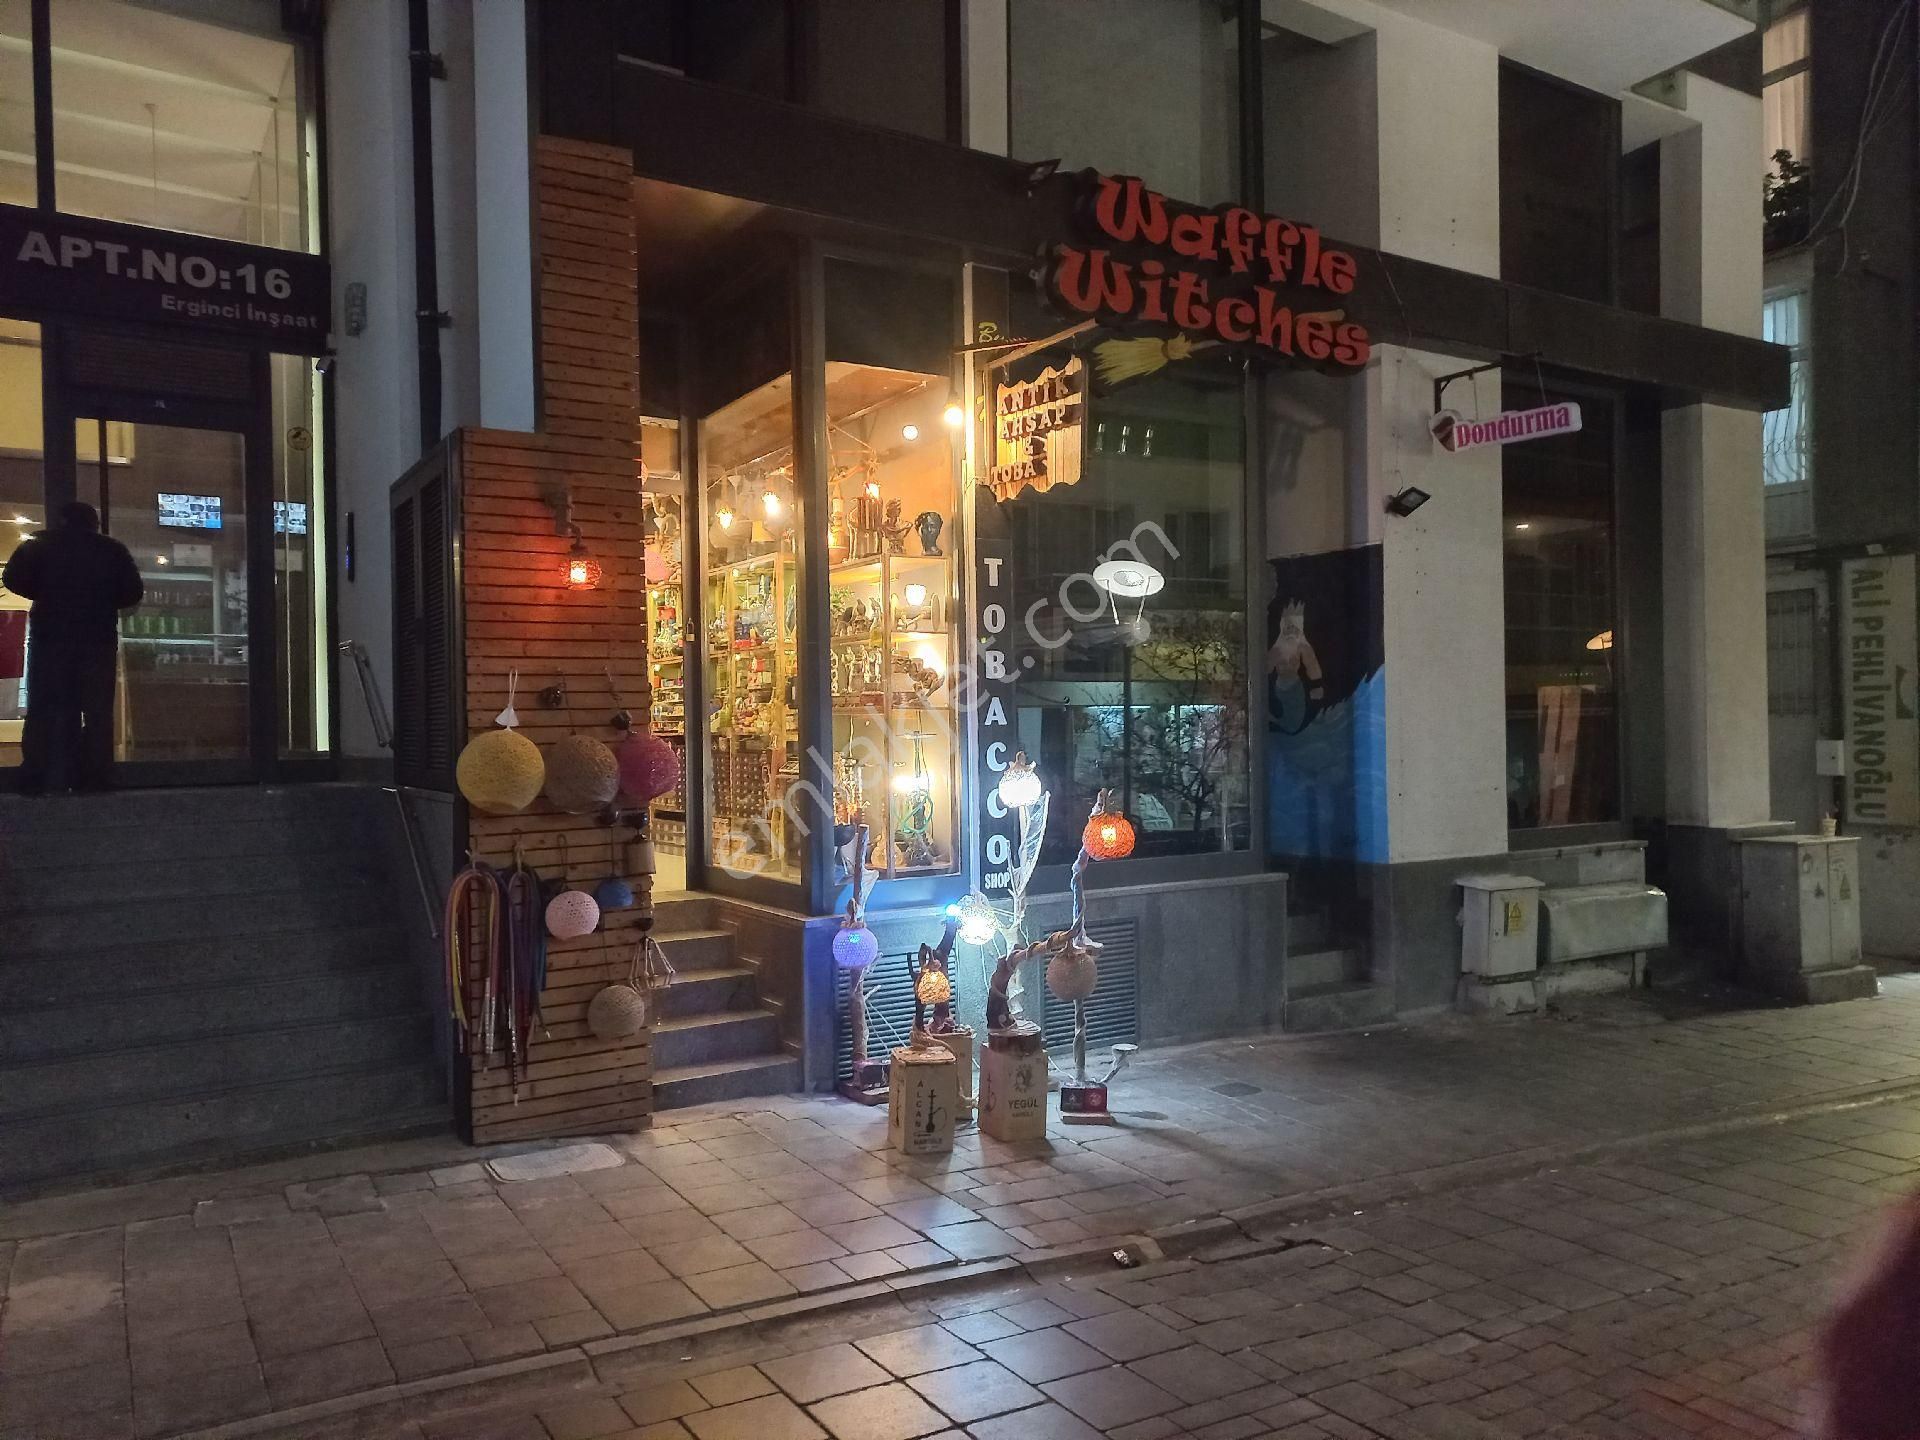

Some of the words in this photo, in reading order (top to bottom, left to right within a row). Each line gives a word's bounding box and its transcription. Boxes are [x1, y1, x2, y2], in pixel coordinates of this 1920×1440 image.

[16, 231, 293, 300] APT.NO:16
[1096, 175, 1358, 295] Waffle
[161, 294, 241, 320] Erginci
[1059, 246, 1371, 366] Witches
[1456, 406, 1570, 448] Dondurma
[983, 557, 1008, 865] TOBACCO
[984, 872, 1010, 890] SHOP
